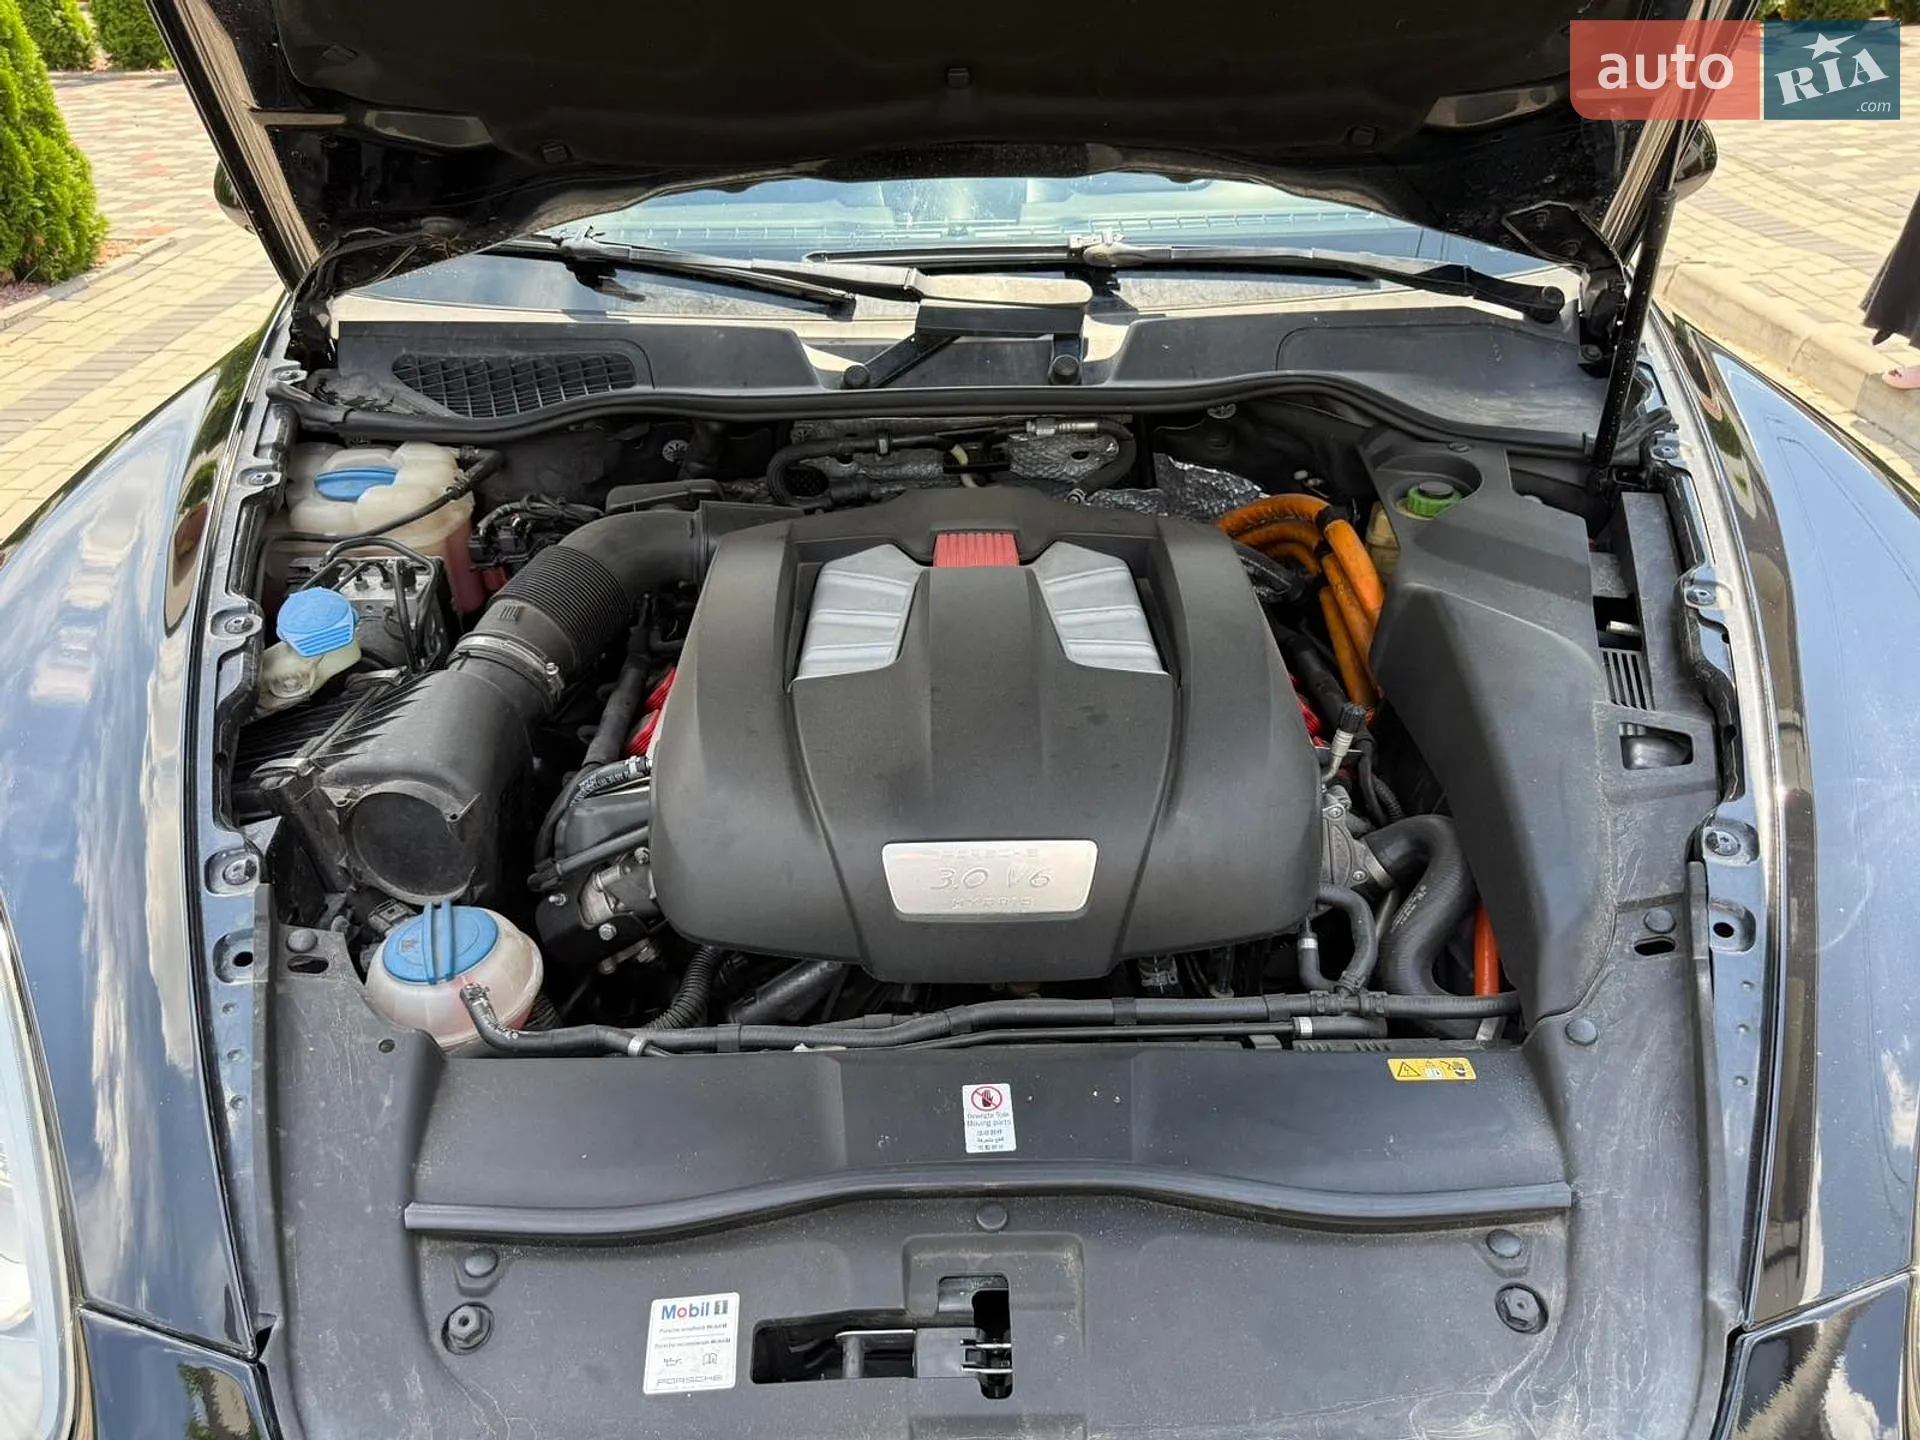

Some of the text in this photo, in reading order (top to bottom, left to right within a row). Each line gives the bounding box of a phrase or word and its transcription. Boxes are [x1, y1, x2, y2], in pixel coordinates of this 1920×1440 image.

[930, 864, 1052, 890] 3.0 V6
[661, 1301, 710, 1320] Mobil
[656, 1374, 723, 1386] PORSCHE
